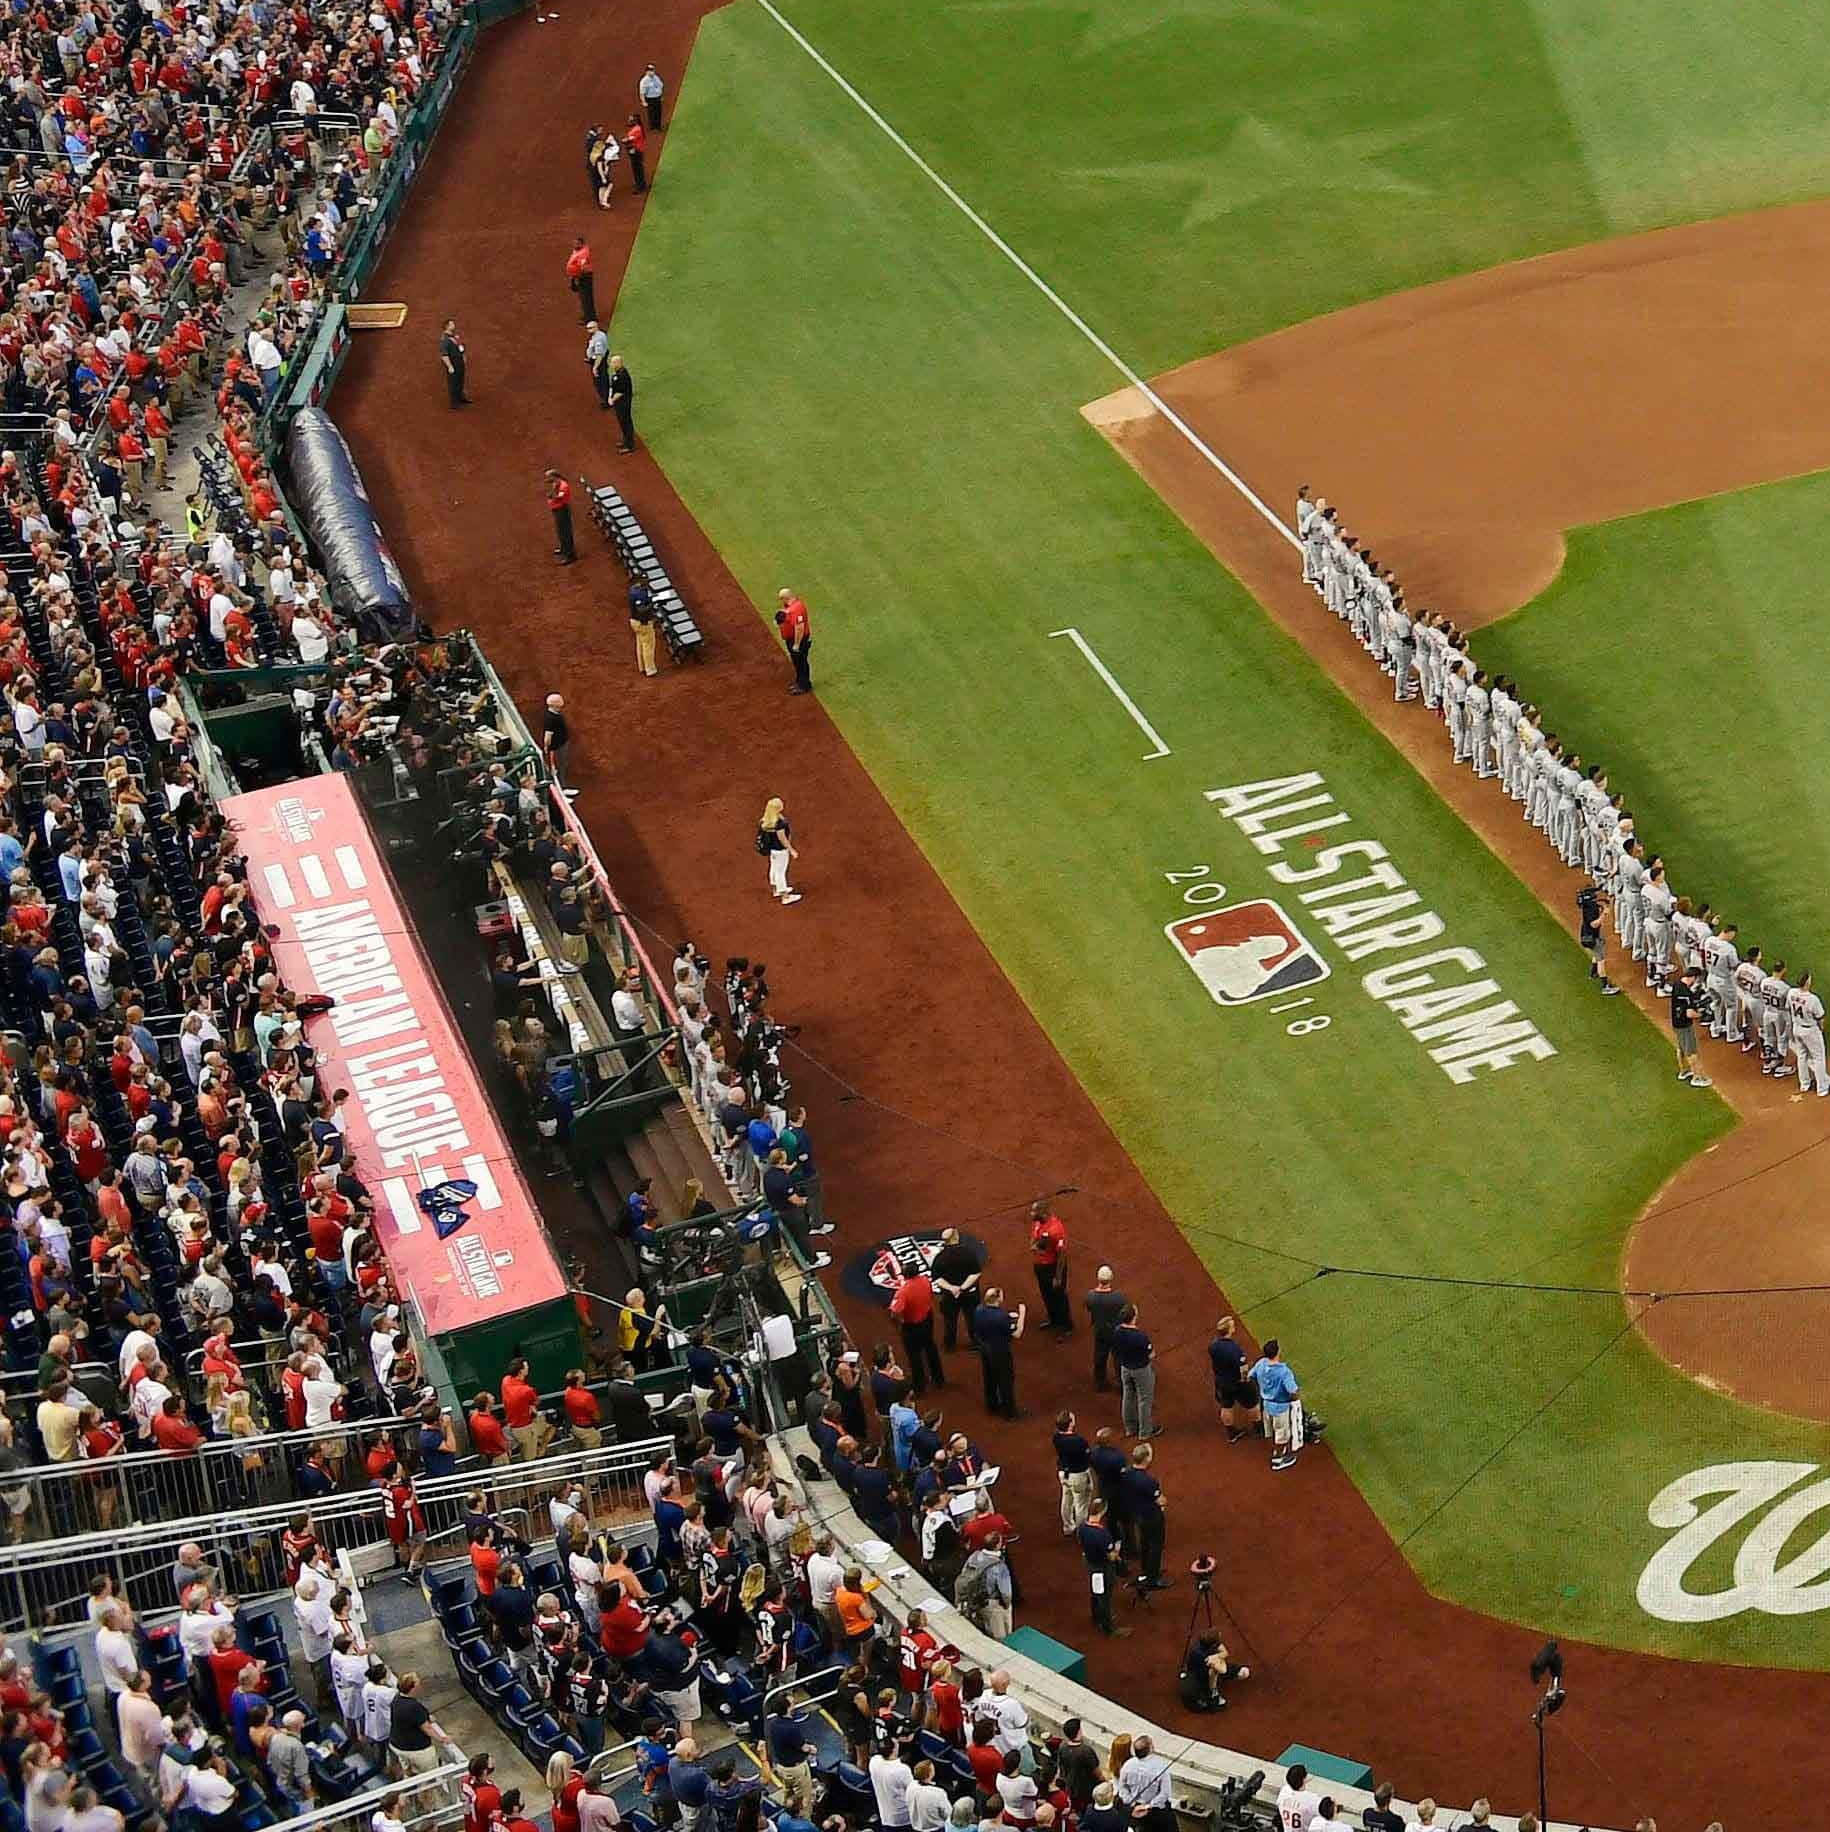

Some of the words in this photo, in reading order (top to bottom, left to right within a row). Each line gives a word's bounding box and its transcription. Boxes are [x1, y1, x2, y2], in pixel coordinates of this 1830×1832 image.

[1203, 771, 1351, 855] ALL
[1267, 840, 1446, 961] STAR
[291, 899, 423, 1047] AMERICAN
[1362, 946, 1559, 1085] GAME
[345, 1039, 470, 1169] LEAGUE
